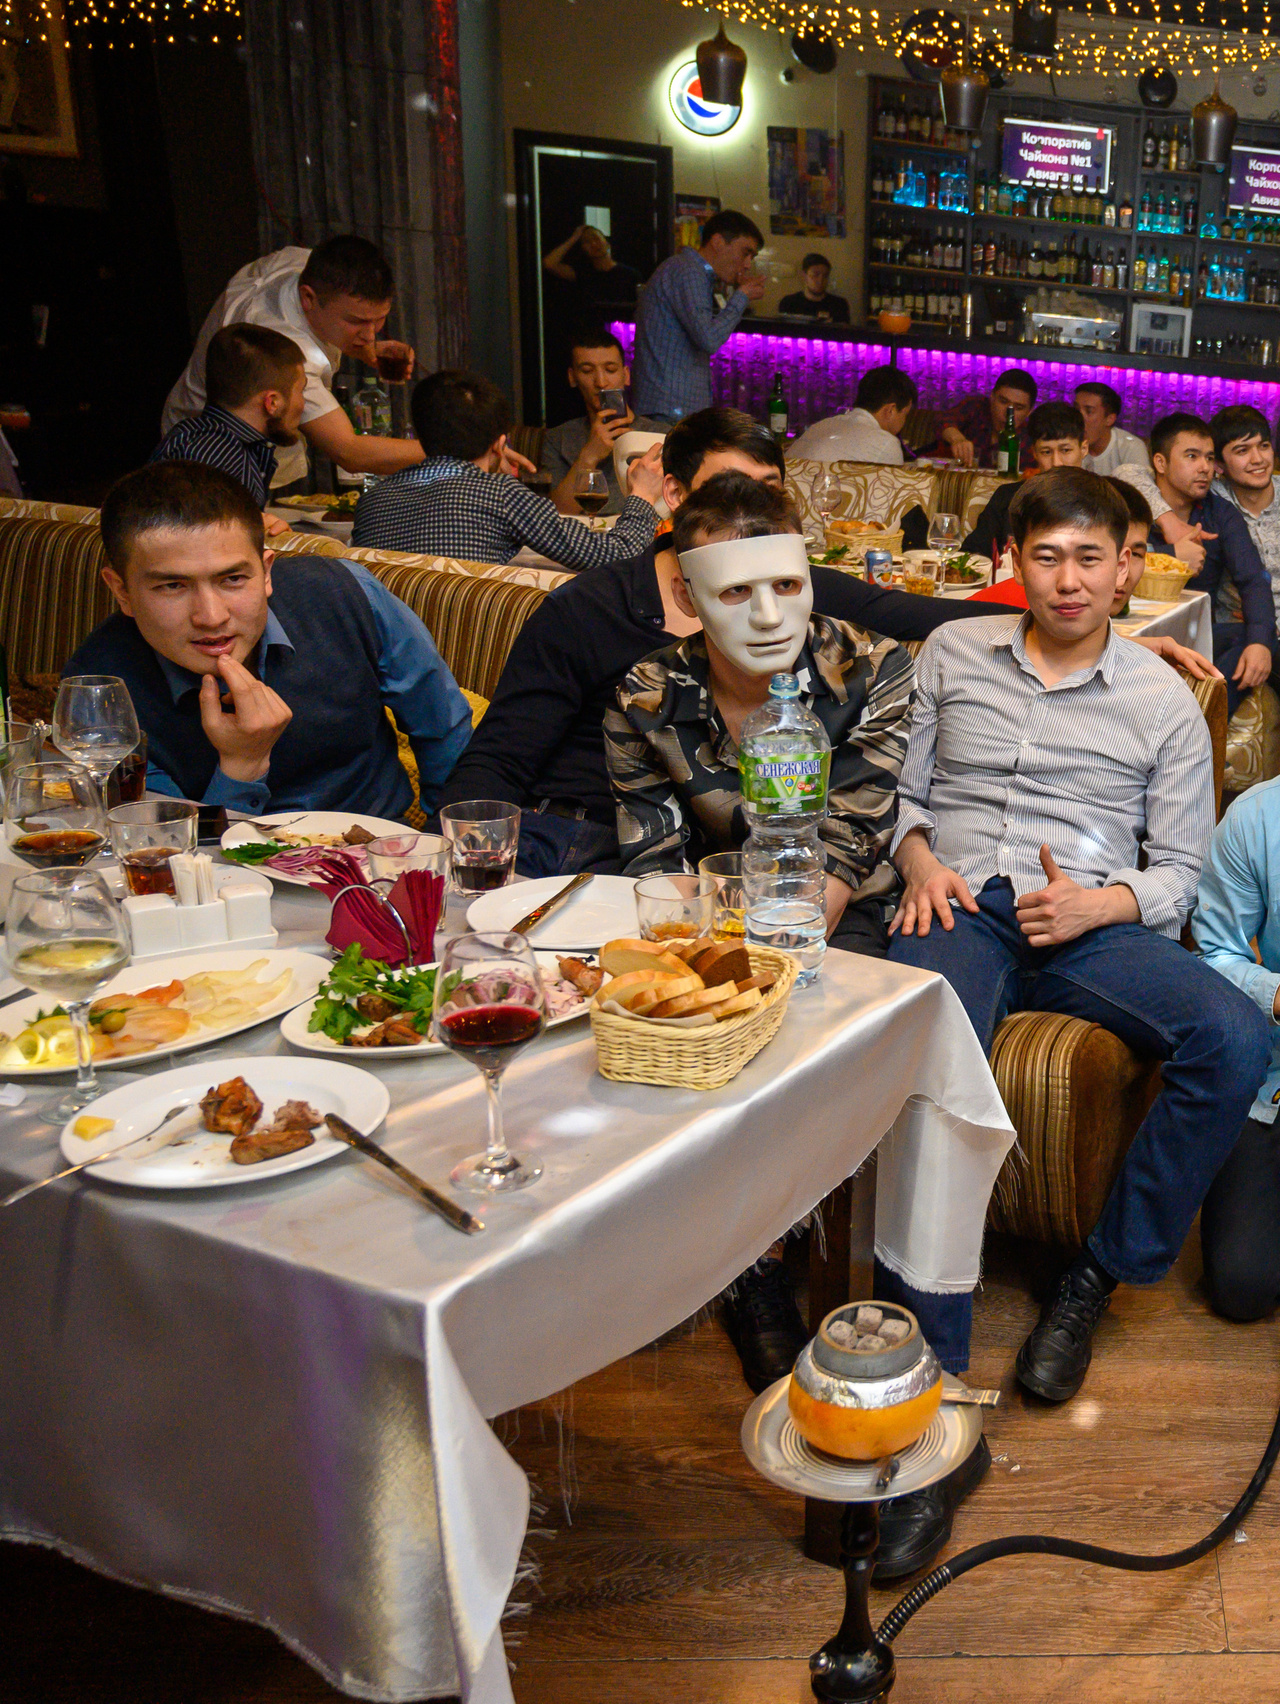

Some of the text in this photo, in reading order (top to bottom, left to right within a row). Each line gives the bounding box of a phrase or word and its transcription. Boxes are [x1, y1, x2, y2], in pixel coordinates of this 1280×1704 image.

[1018, 148, 1092, 168] Чайхона №1
[756, 759, 821, 778] СЕНЕЖСКАЯ
